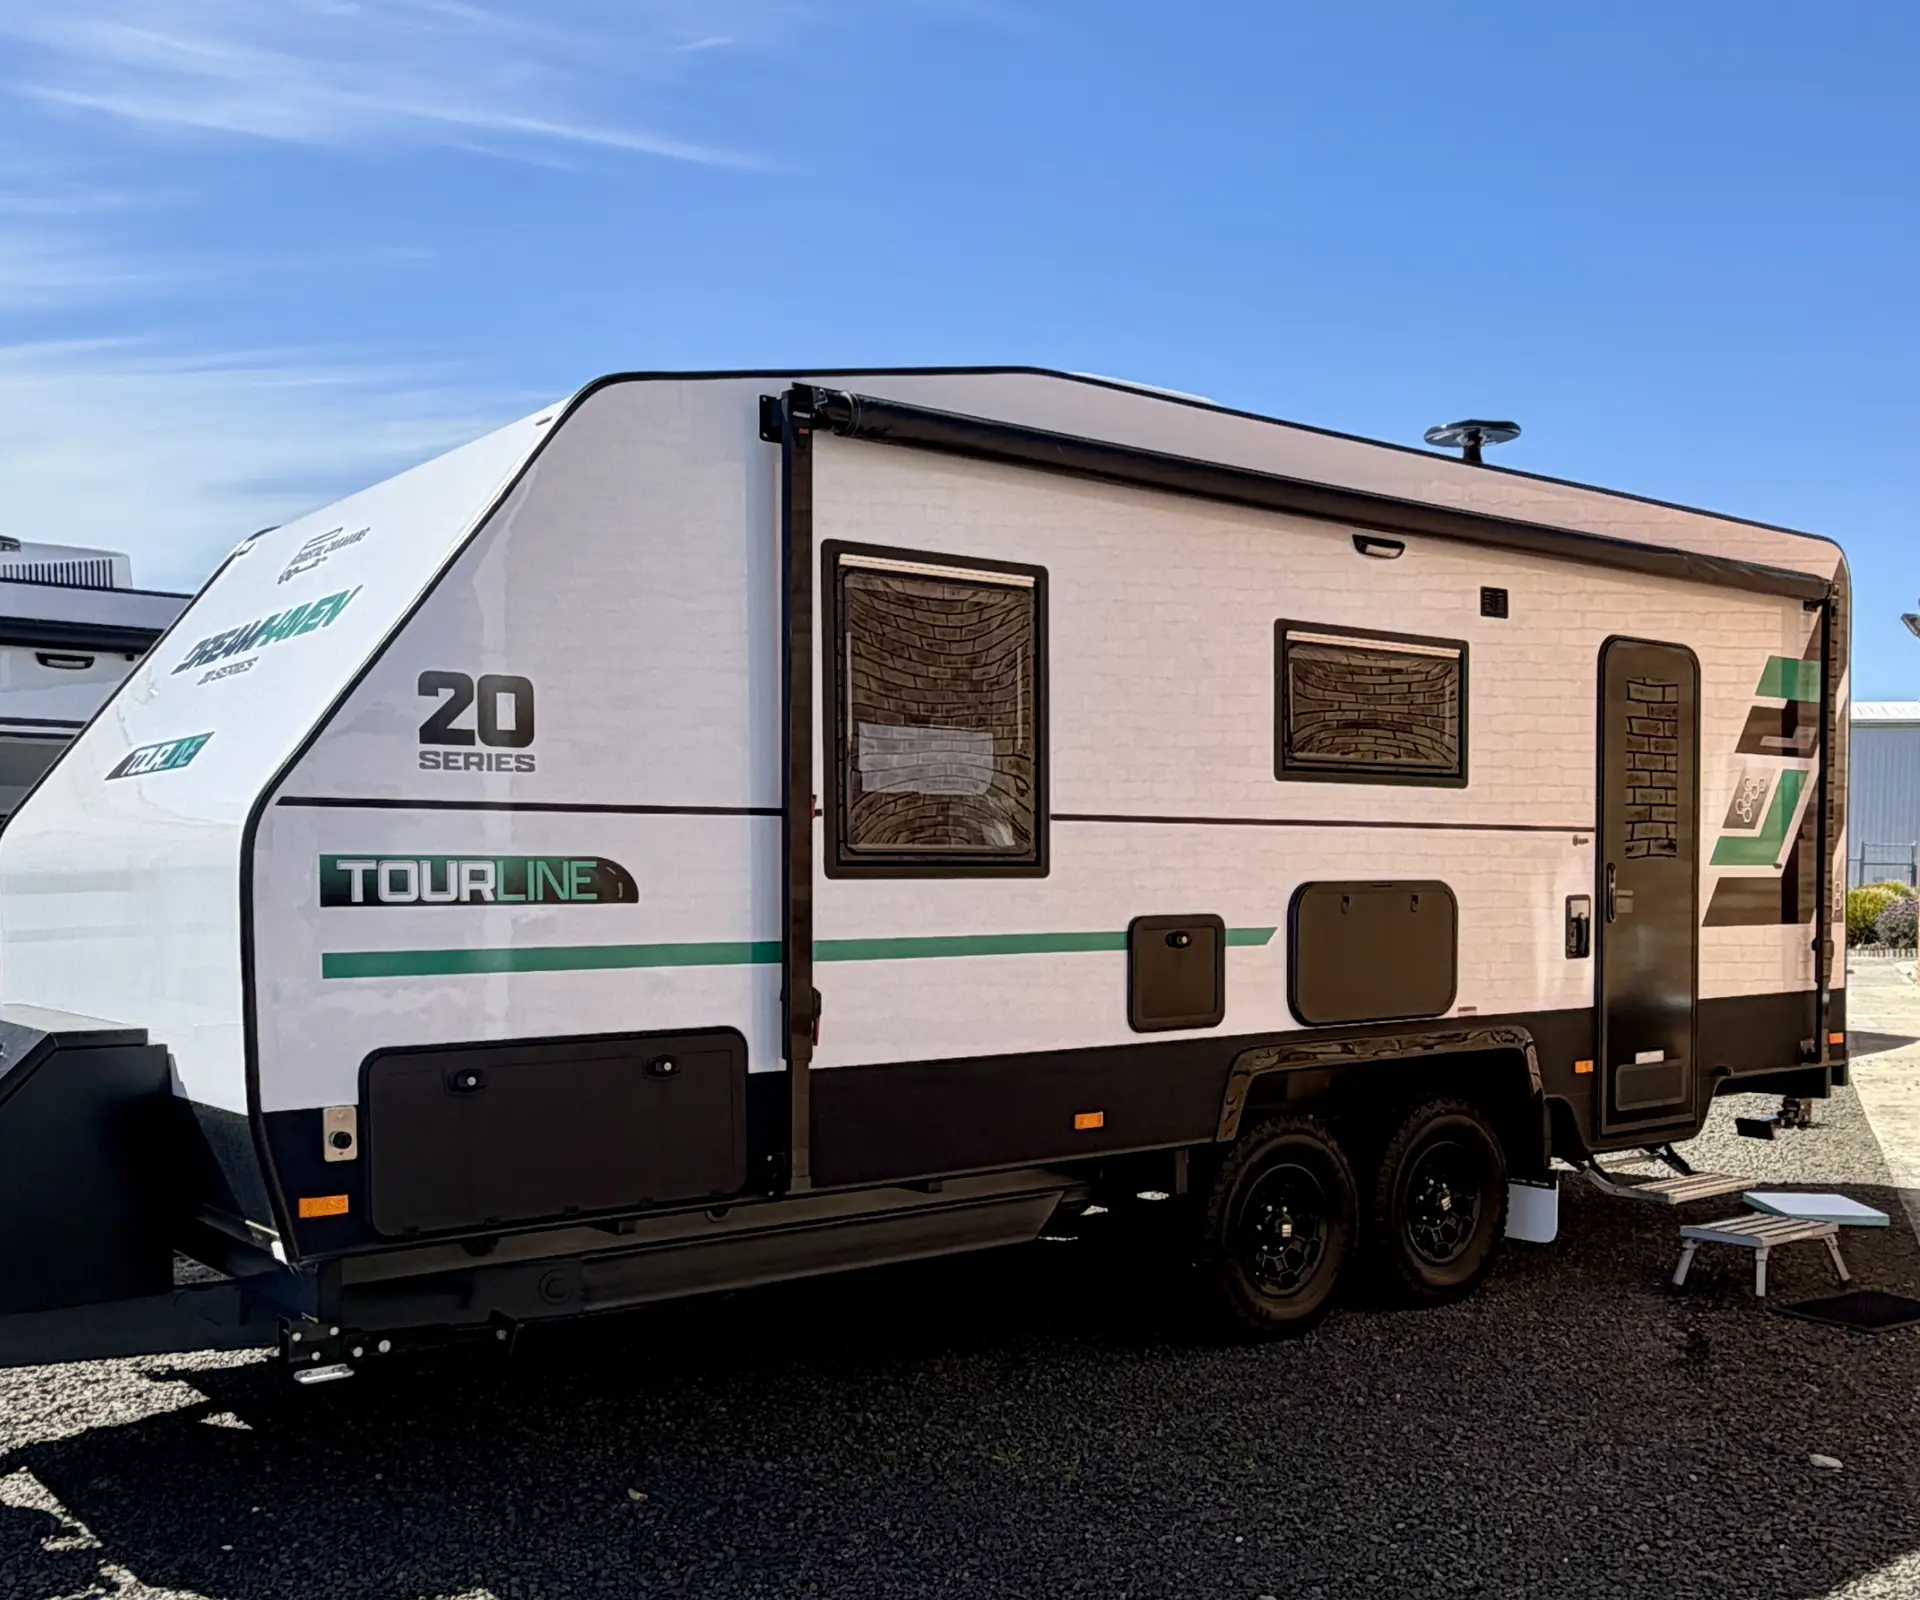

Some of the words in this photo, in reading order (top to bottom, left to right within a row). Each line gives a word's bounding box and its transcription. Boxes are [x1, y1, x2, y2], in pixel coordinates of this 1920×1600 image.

[170, 584, 364, 675] DREAMHAVEN
[418, 670, 535, 748] 20
[121, 736, 208, 777] TOURLINE
[418, 750, 536, 773] SERIES
[336, 859, 598, 903] TOURLINE
